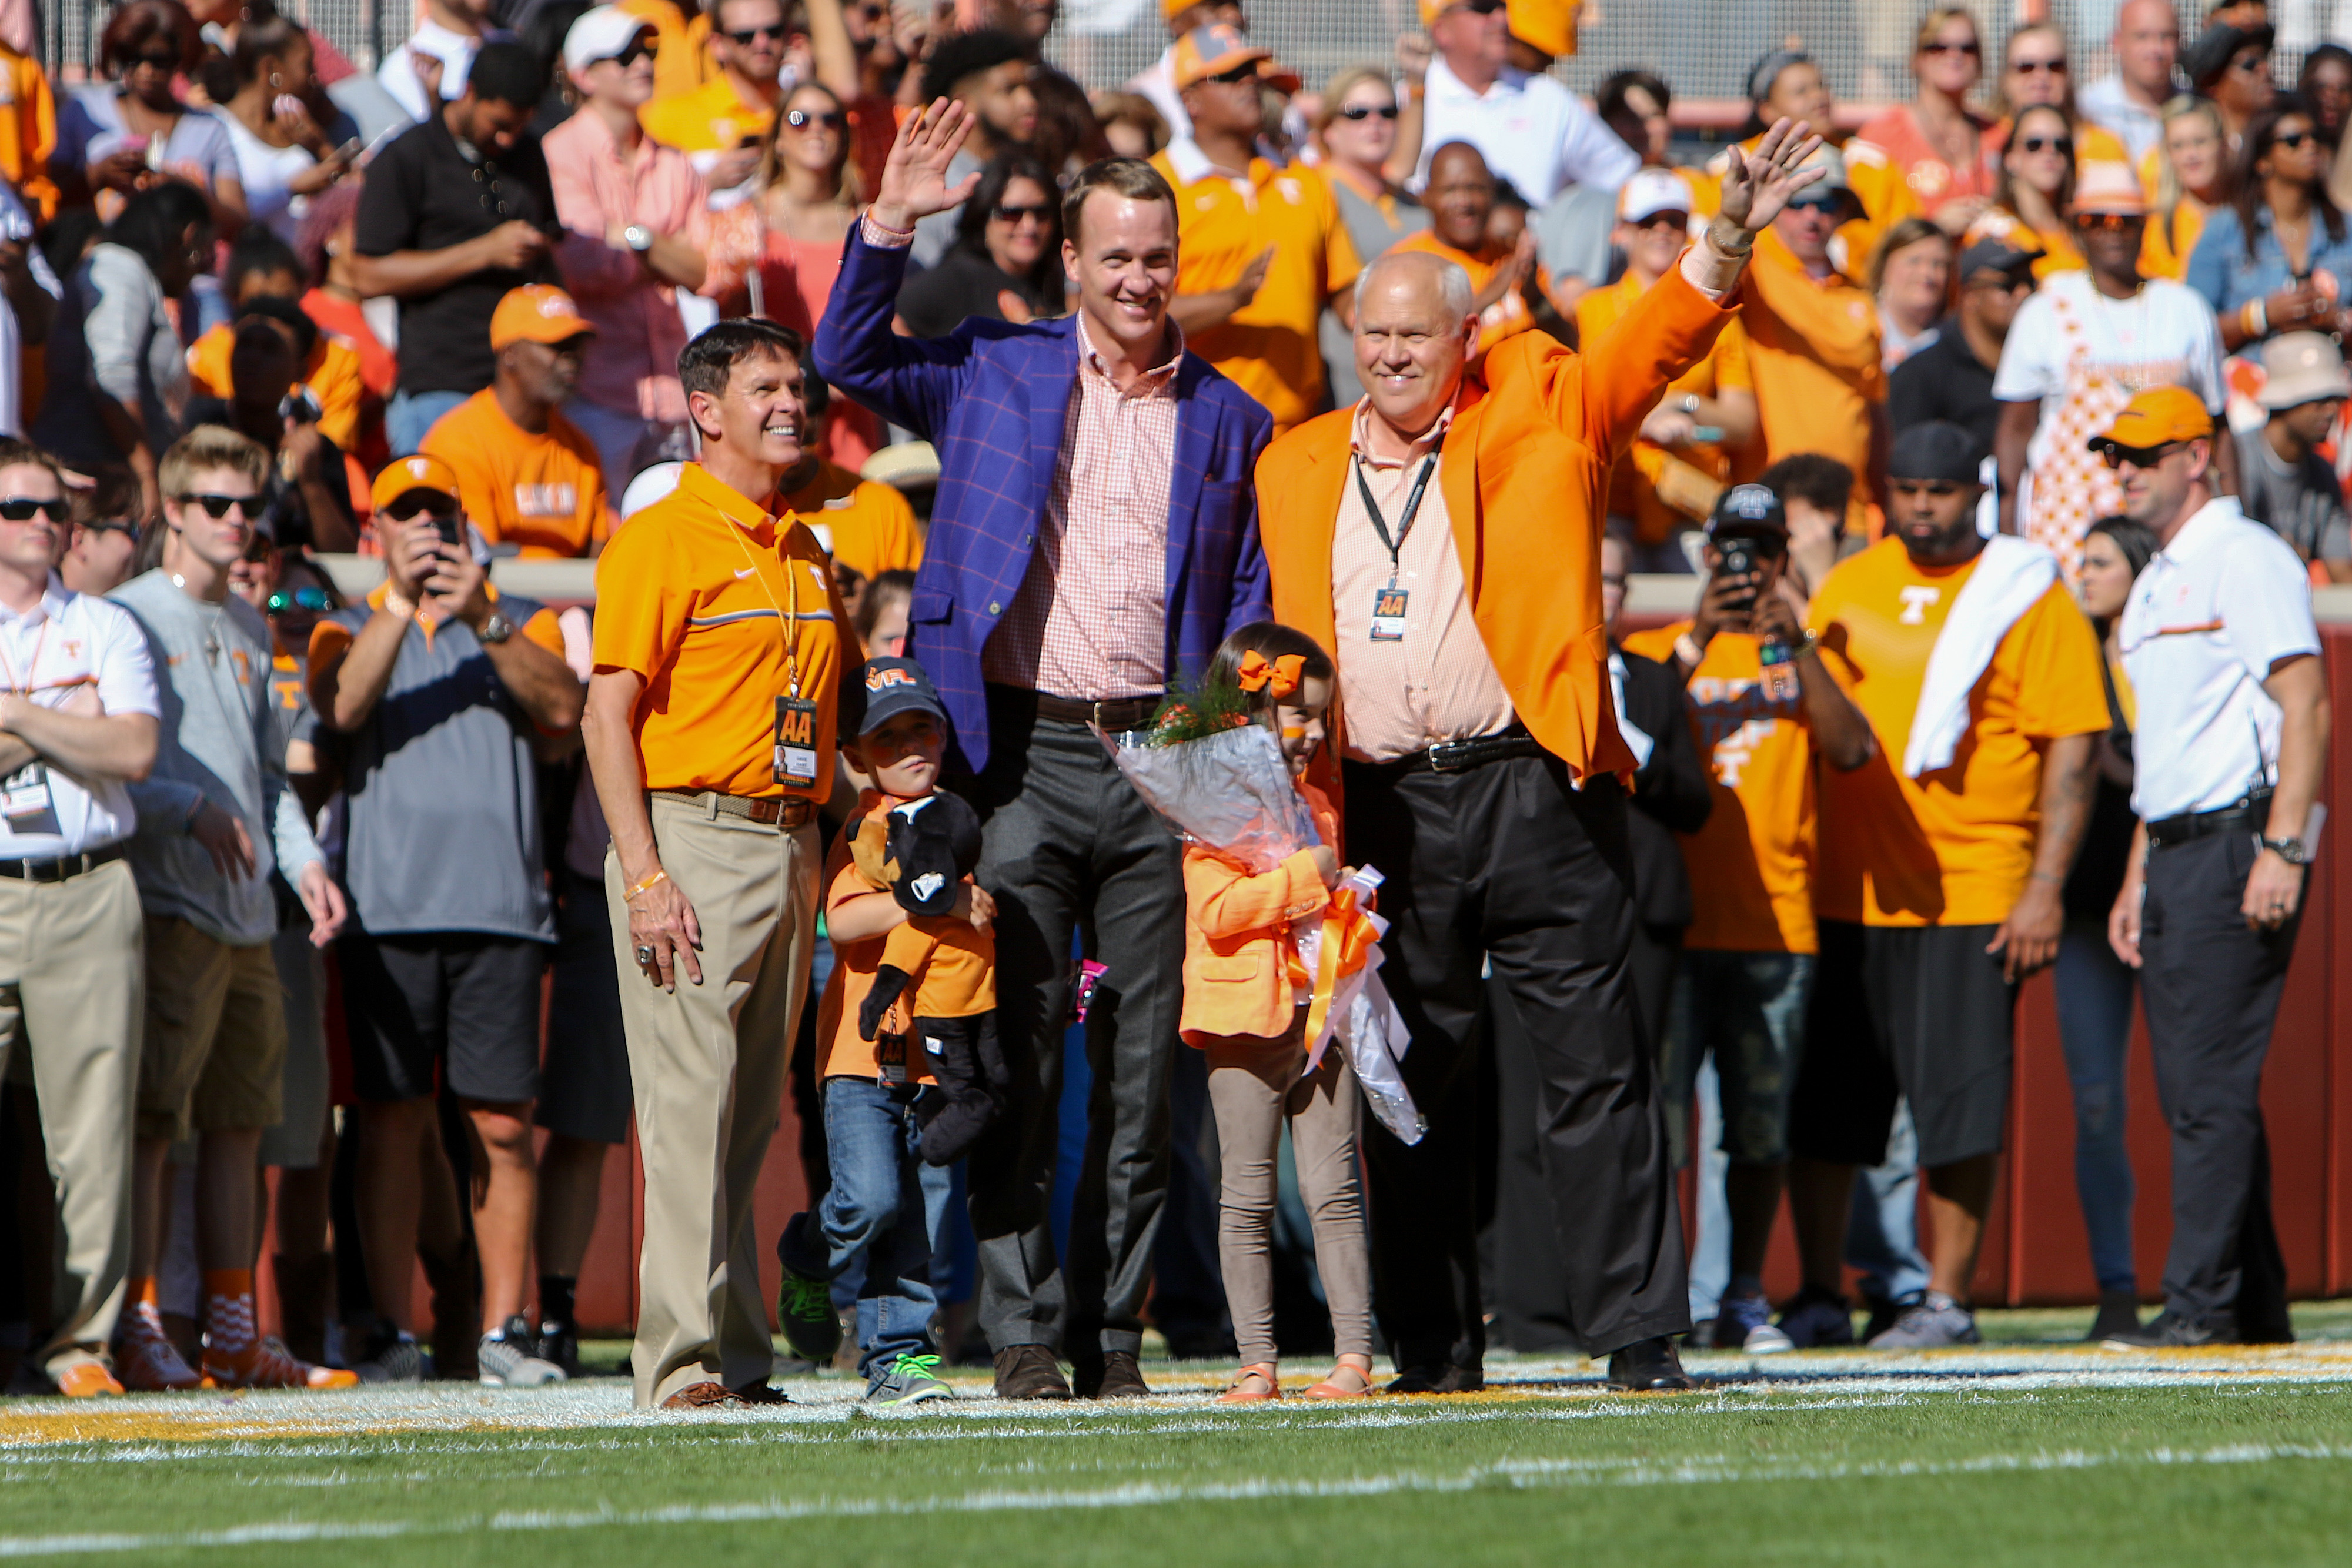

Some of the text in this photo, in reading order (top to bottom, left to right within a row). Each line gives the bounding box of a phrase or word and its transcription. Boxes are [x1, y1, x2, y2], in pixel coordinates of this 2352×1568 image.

[1377, 595, 1404, 615] AA
[1899, 584, 1941, 625] T
[865, 667, 917, 693] VFL
[274, 680, 303, 709] T
[779, 709, 811, 744] AA
[779, 773, 810, 784] TENNESSEE
